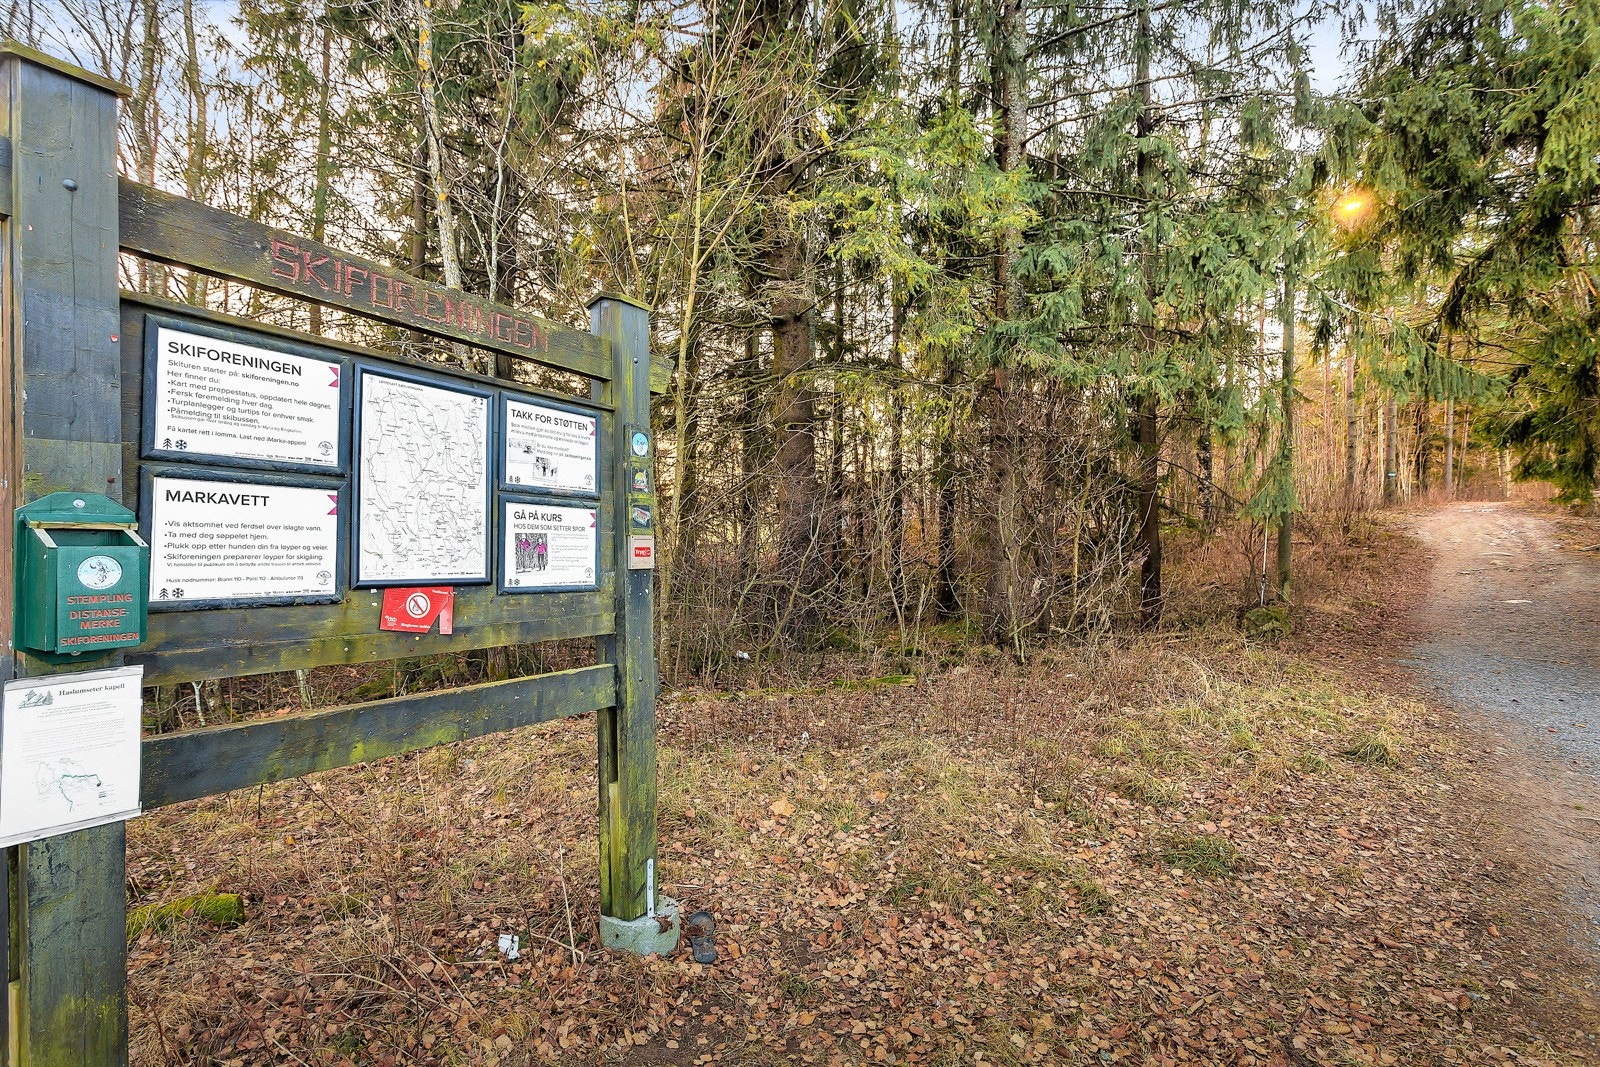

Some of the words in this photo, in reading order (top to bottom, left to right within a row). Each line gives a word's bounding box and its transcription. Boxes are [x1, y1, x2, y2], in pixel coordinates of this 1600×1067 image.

[271, 238, 549, 352] SKIFORENINGEN
[168, 341, 302, 376] SKIFORENINGEN
[167, 370, 182, 378] Her
[184, 372, 207, 382] finner
[168, 359, 201, 370] Skituren
[203, 366, 227, 375] starter
[241, 372, 300, 387] skiforeningen.no
[189, 383, 207, 391] med
[208, 386, 258, 399] preppestatus,
[259, 393, 292, 404] oppdatert
[293, 398, 308, 406] hele
[226, 406, 237, 414] og
[238, 407, 260, 416] turtips
[272, 412, 296, 421] enhver
[511, 409, 533, 421] TAKK
[535, 413, 552, 425] FOR
[553, 417, 588, 431] STØTTEN
[177, 426, 198, 435] kartet
[215, 431, 238, 439] lomma.
[239, 433, 253, 441] Last
[165, 489, 270, 507] MARKAVETT
[513, 509, 527, 520] GÅ
[528, 510, 539, 521] PÅ
[540, 513, 563, 522] KURS
[182, 521, 223, 529] aktsomhet
[198, 532, 215, 540] deg
[249, 533, 269, 541] hjem.
[191, 543, 207, 551] opp
[67, 593, 133, 605] STEMPLING
[69, 607, 130, 620] DISTANSE-
[79, 620, 120, 630] MERKE
[60, 632, 139, 646] SKIFORENINGEN
[59, 686, 103, 696] Haslumseter
[104, 683, 125, 691] kapell
